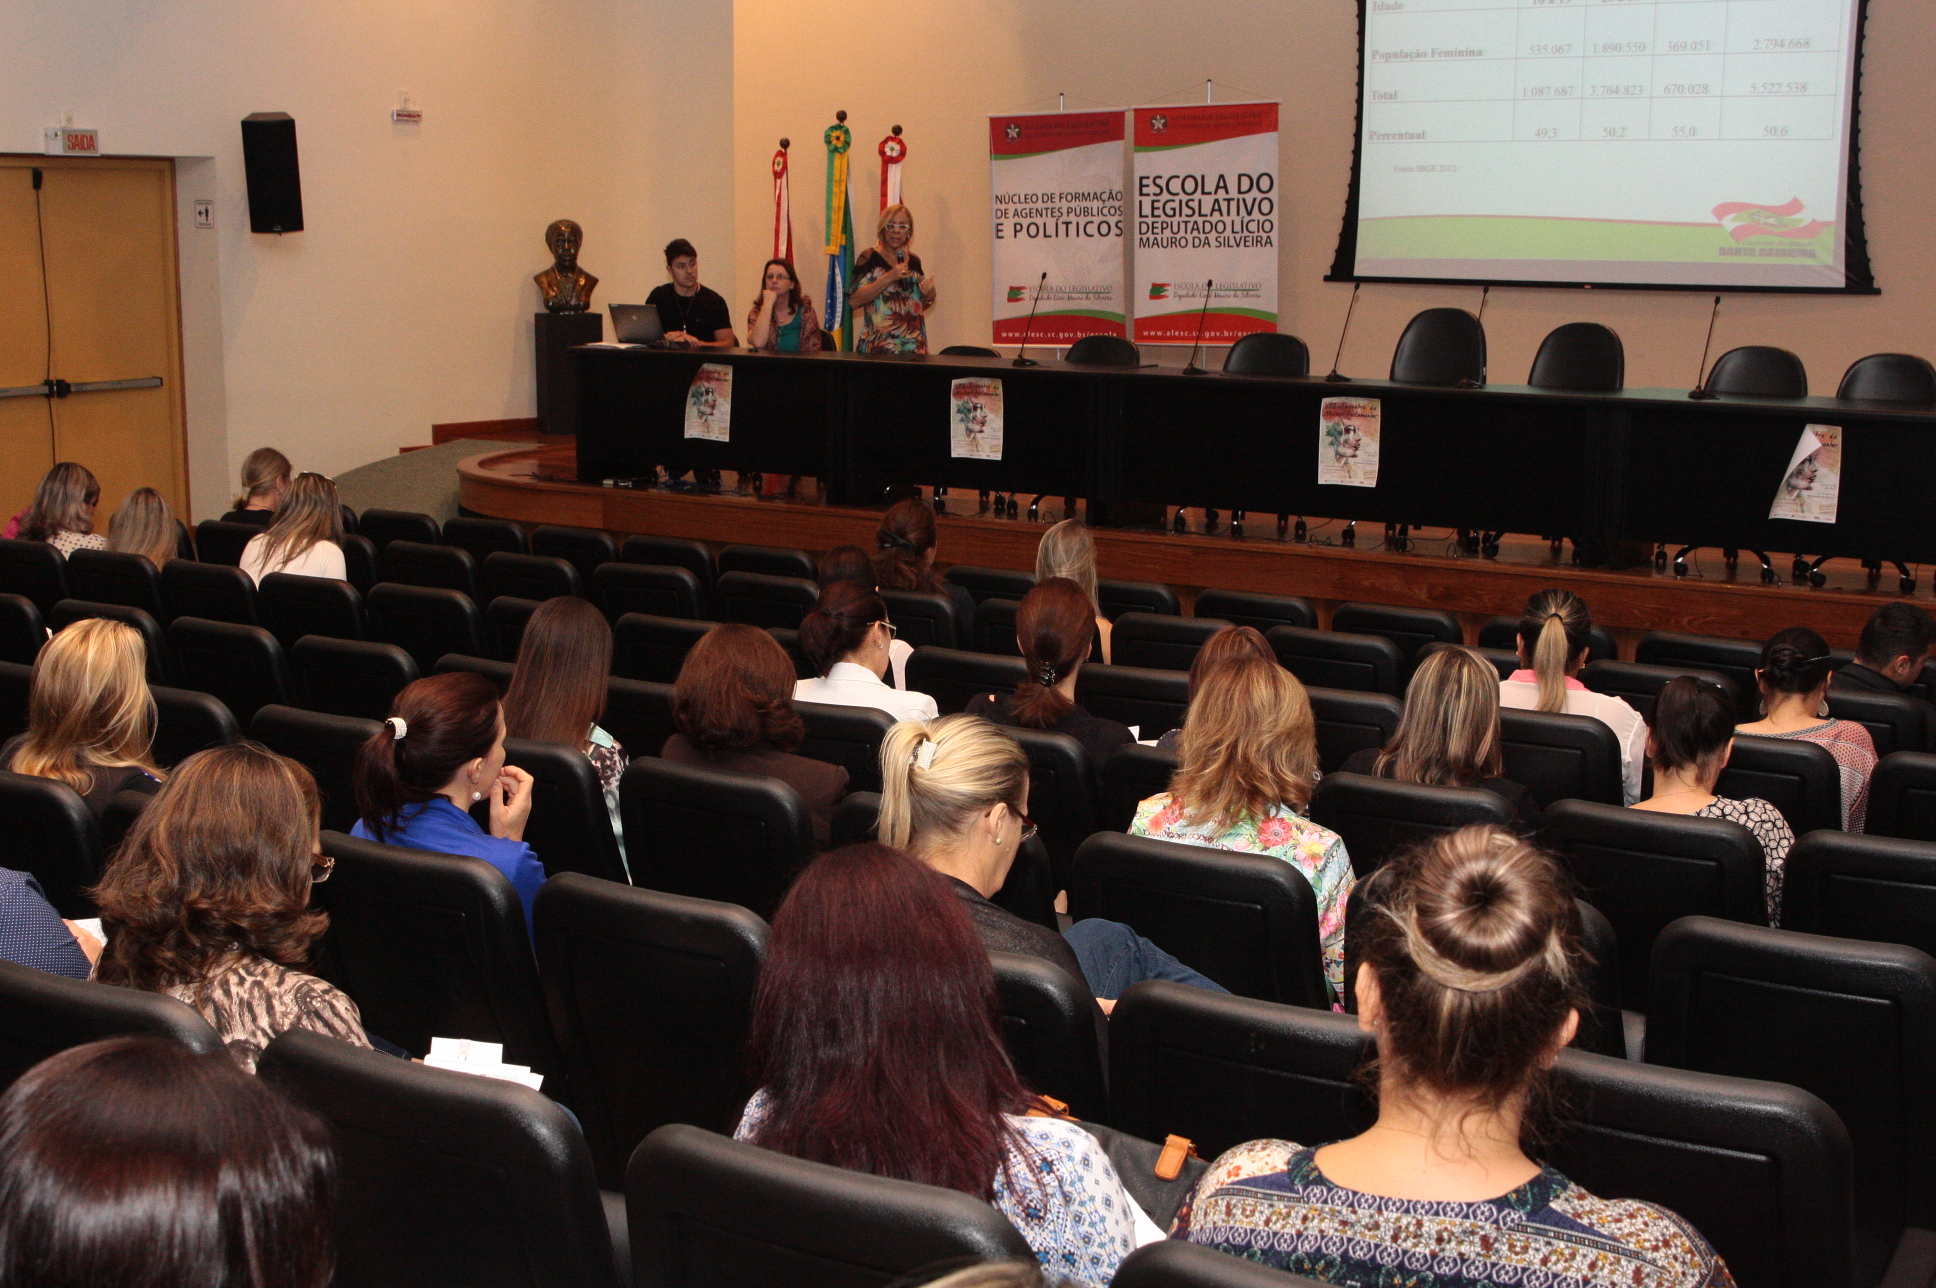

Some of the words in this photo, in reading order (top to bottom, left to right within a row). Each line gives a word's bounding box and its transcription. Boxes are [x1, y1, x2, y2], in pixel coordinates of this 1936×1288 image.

[1371, 48, 1427, 62] População
[1430, 47, 1483, 59] Feminina
[1528, 44, 1572, 55] 535.067
[1592, 42, 1646, 54] 1.890.550
[1666, 40, 1710, 52] 369.051
[1752, 38, 1811, 50] 2.794.668
[1371, 90, 1397, 100] Total
[1522, 86, 1574, 97] 1.087.687
[1589, 85, 1643, 96] 3.764.823
[1663, 84, 1708, 95] 670.028
[1750, 82, 1807, 94] 5.522.538
[1369, 129, 1426, 141] Percentual
[1138, 174, 1230, 197] ESCOLA
[1237, 172, 1274, 195] DO
[994, 192, 1039, 205] NÚCLEO
[1041, 192, 1056, 204] DE
[1058, 188, 1123, 205] FORMAÇÃO
[995, 208, 1010, 220] DE
[1012, 206, 1064, 219] AGENTES
[1066, 204, 1123, 218] PÚBLICOS
[1138, 196, 1274, 218] LEGISLATIVO
[995, 222, 1005, 239] E
[1013, 217, 1123, 239] POLÍTICOS
[1138, 220, 1227, 236] DEPUTADO
[1231, 215, 1274, 235] LÍCIO
[1138, 236, 1189, 249] MAURO
[1192, 236, 1211, 249] DA
[1214, 234, 1274, 248] SILVEIRA
